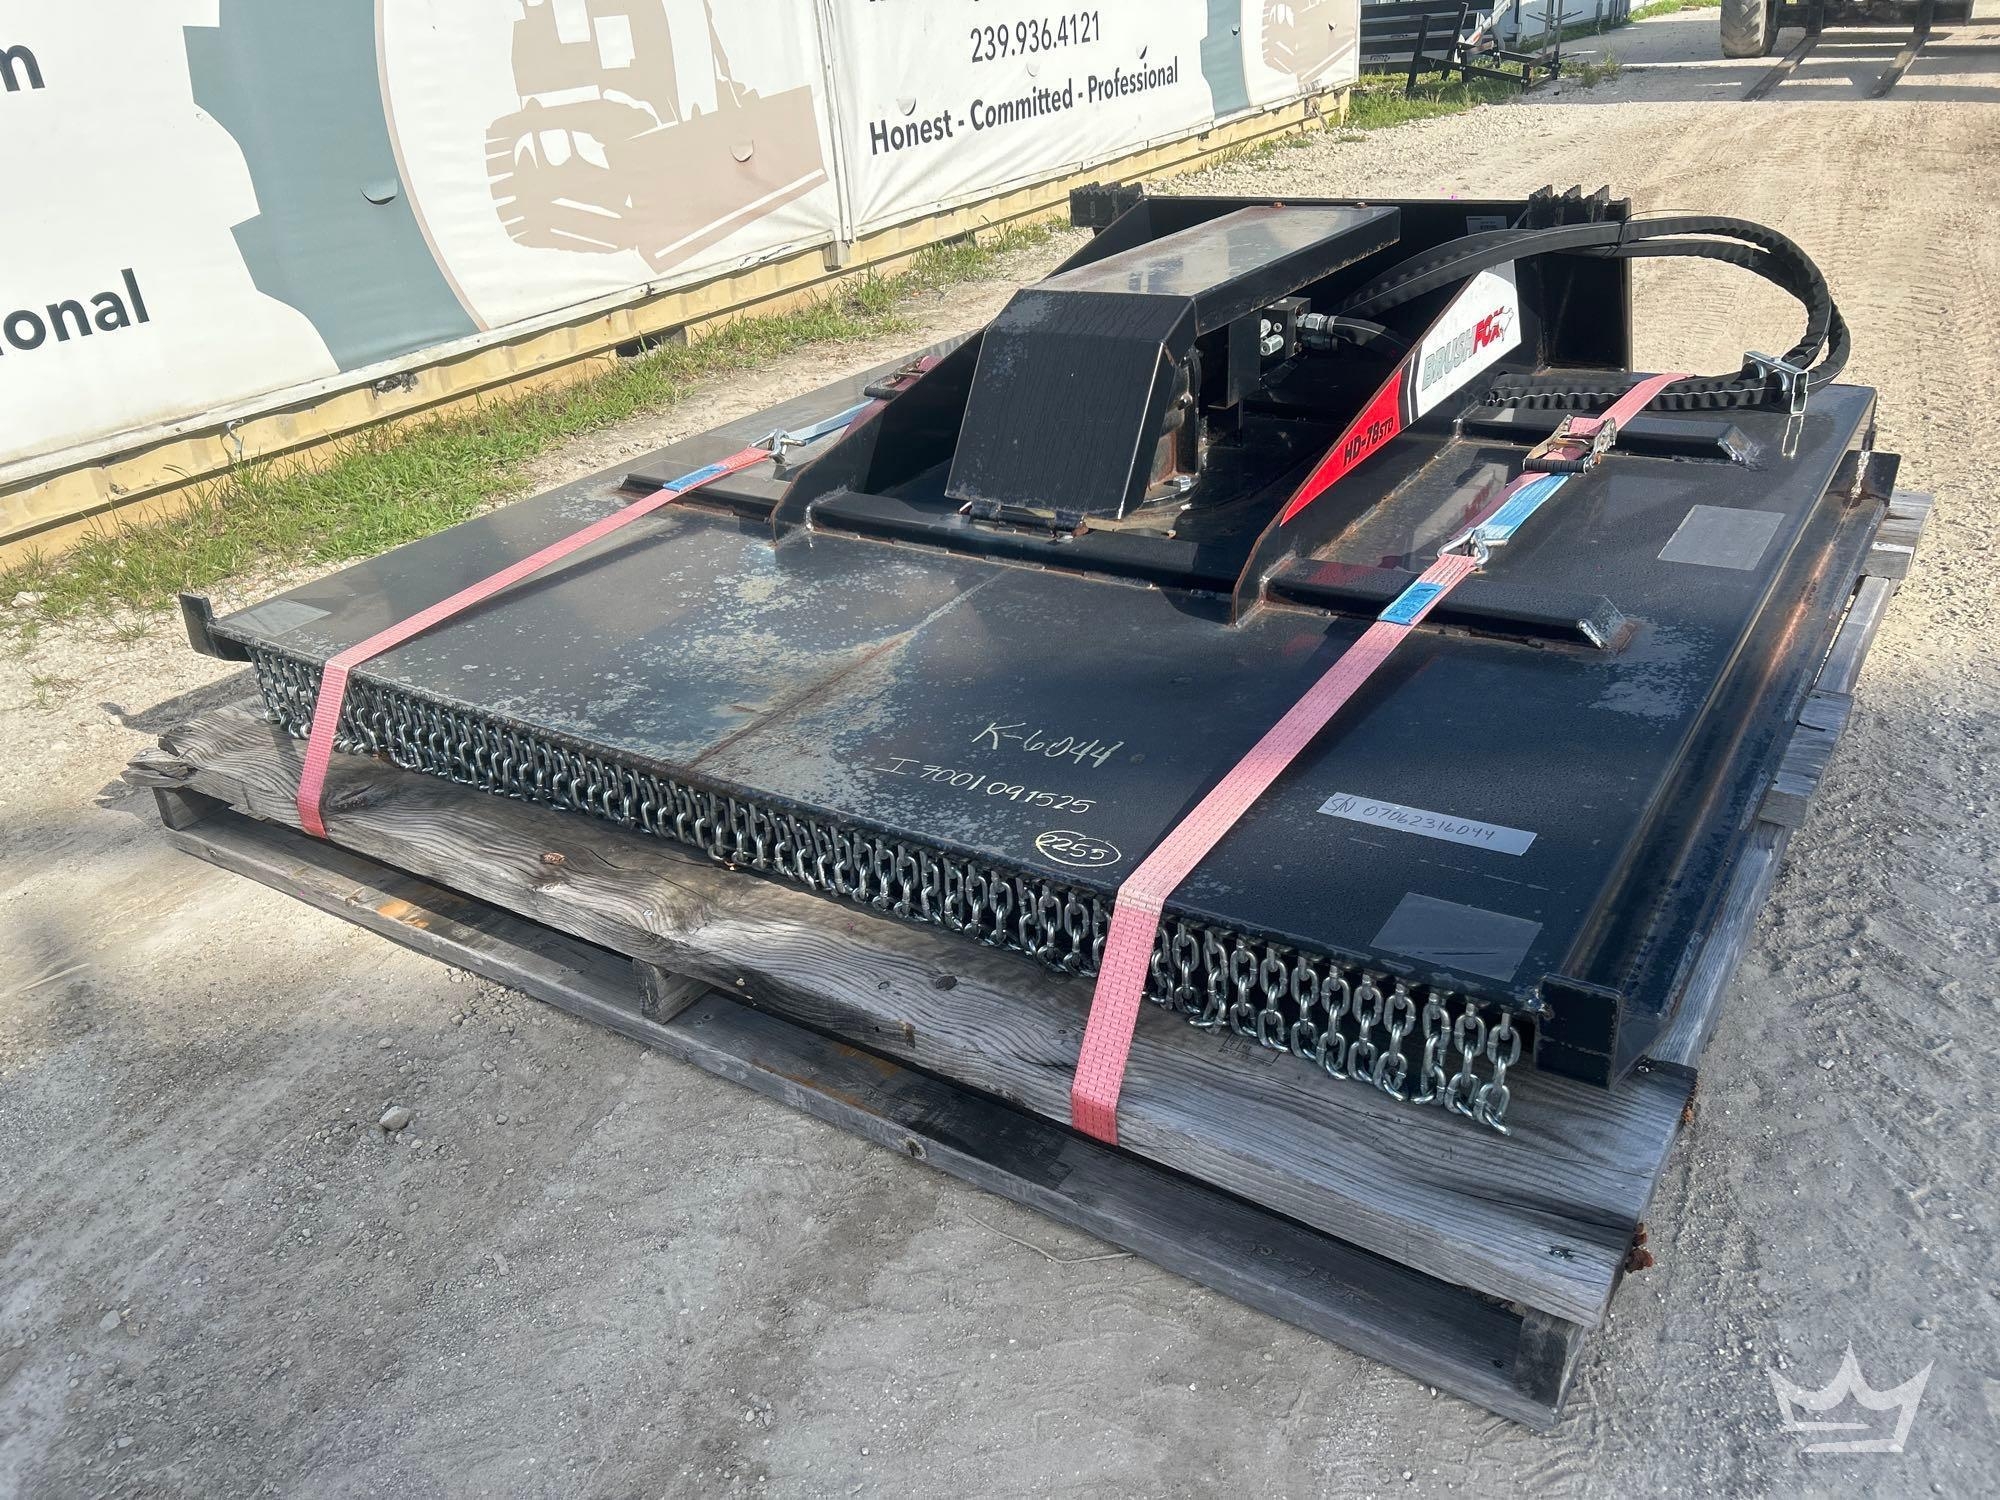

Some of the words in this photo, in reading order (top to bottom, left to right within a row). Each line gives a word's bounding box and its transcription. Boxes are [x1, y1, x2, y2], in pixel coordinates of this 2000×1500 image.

[970, 11, 1100, 64] 239.936.4121
[869, 109, 954, 156] Honest
[970, 78, 1074, 132] Committed
[1088, 55, 1179, 104] Professional
[0, 267, 151, 356] onal
[971, 722, 1125, 769] K-6044
